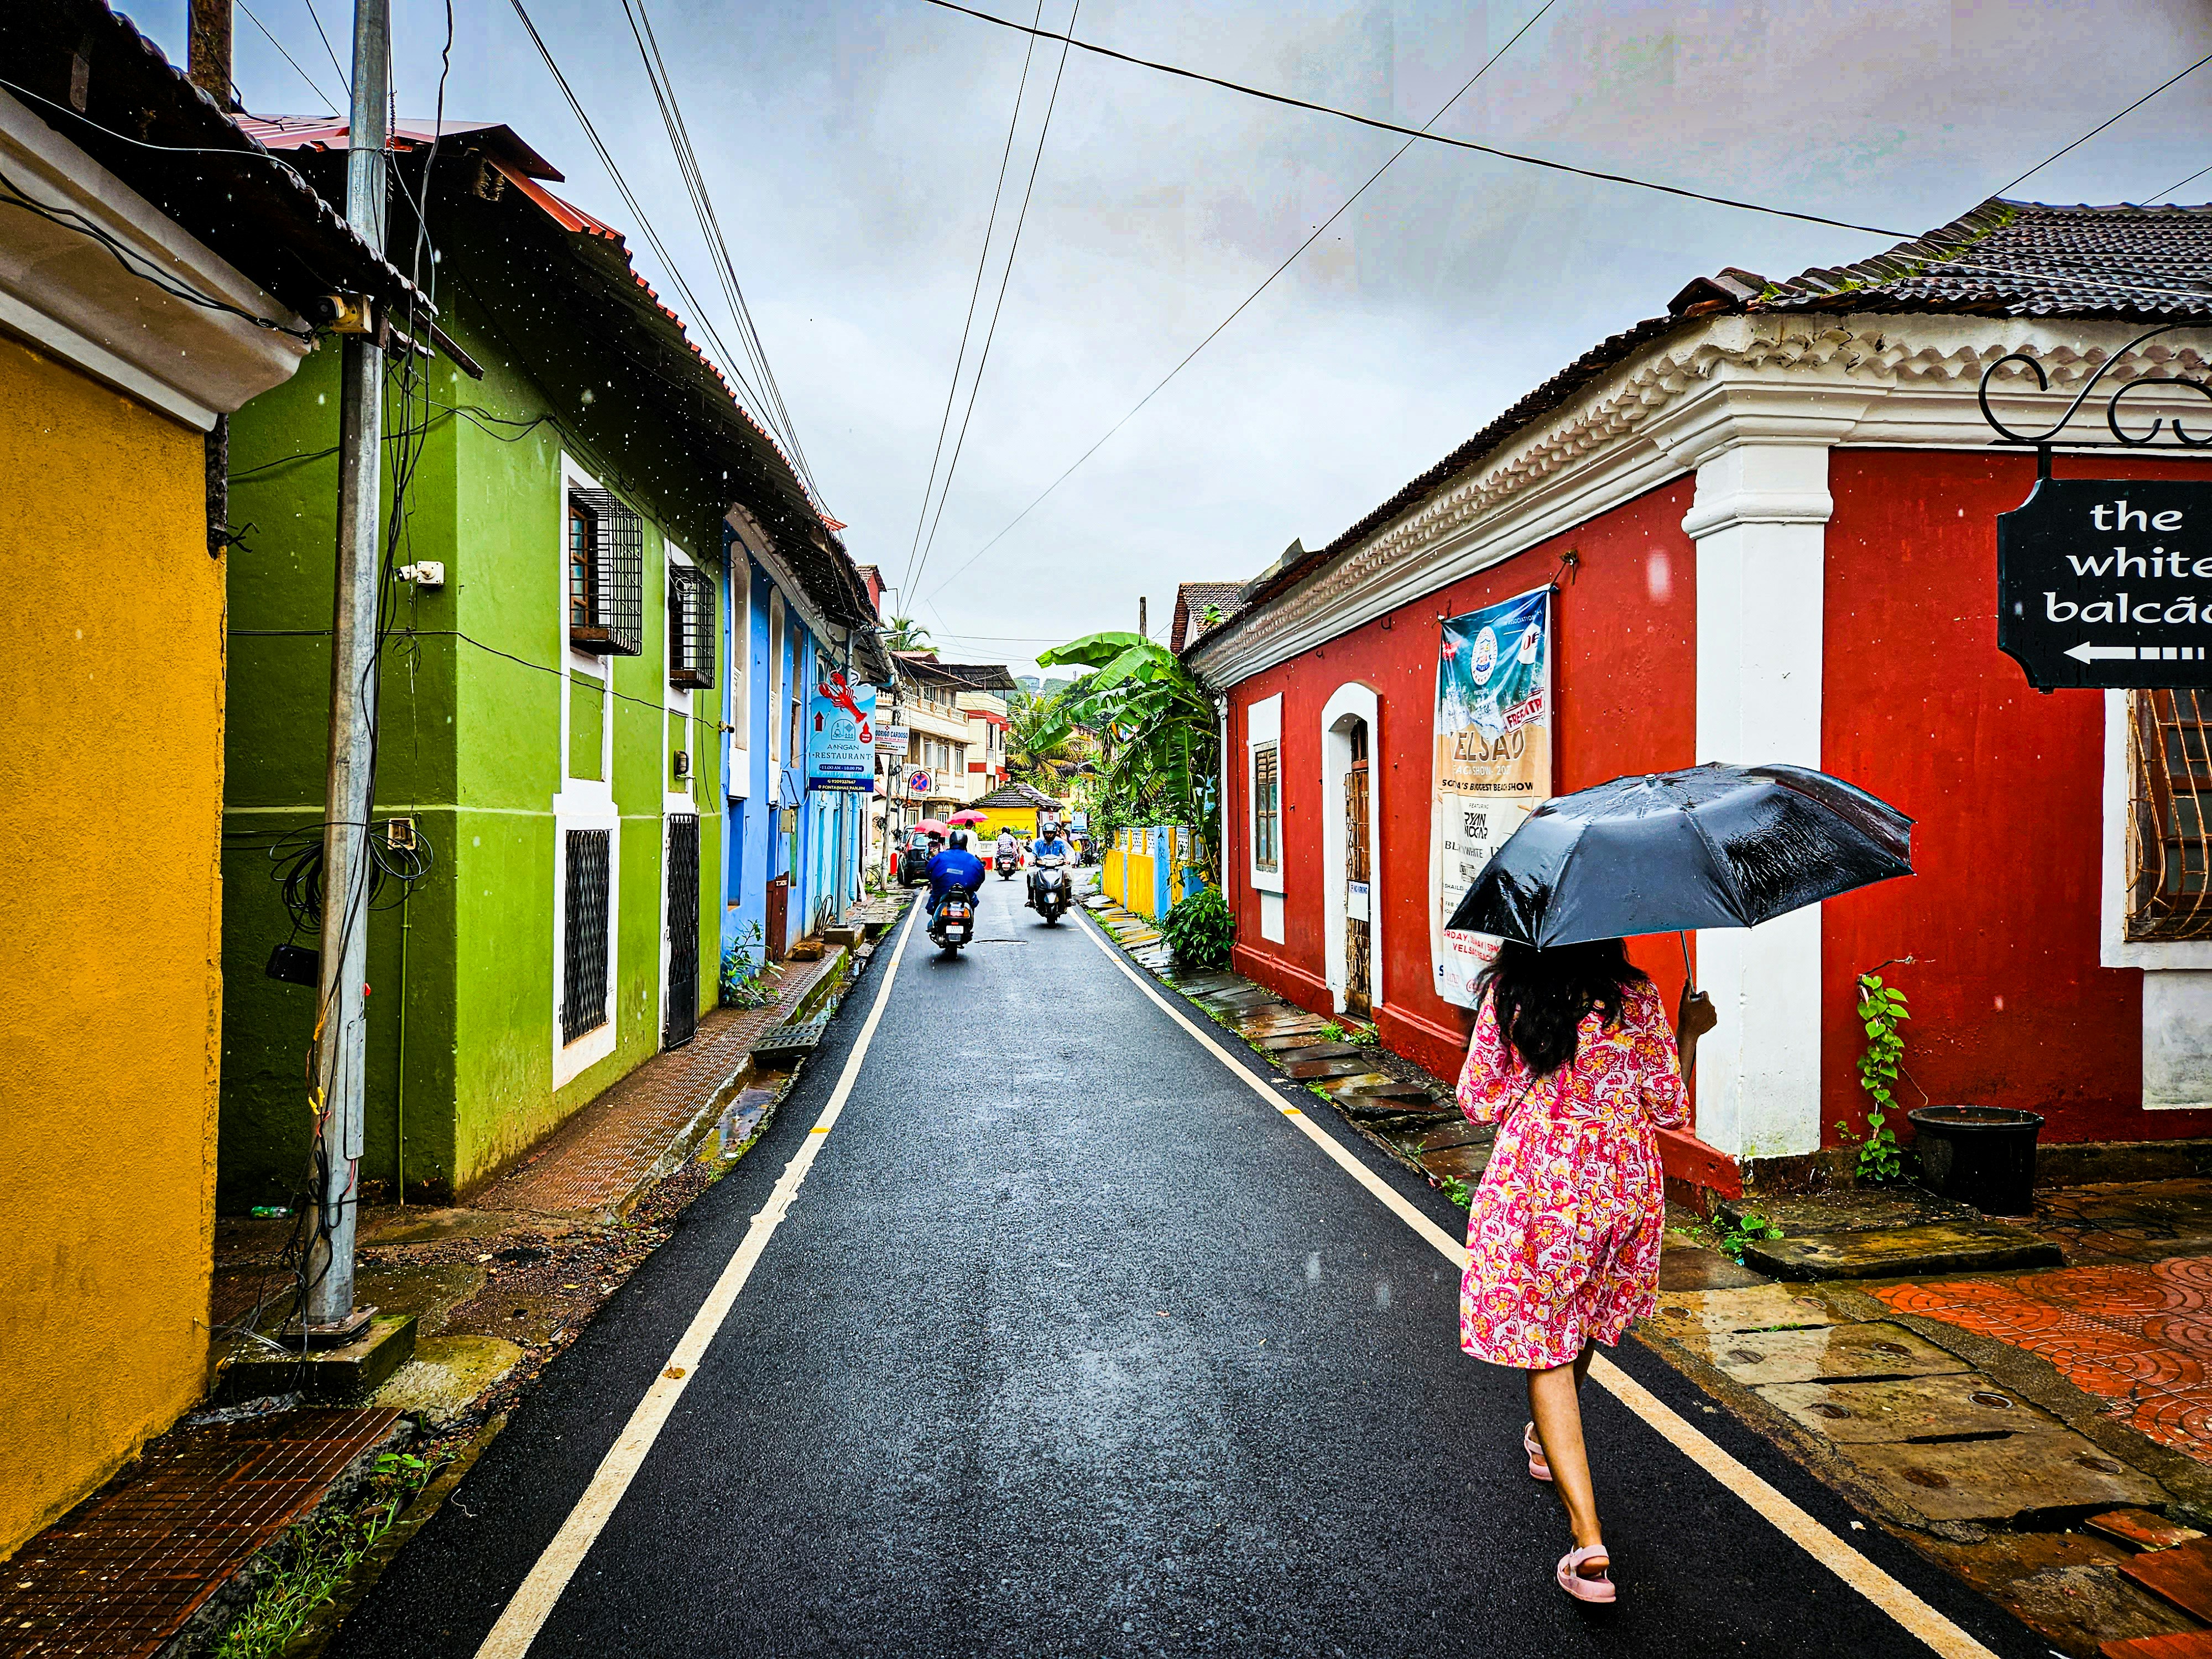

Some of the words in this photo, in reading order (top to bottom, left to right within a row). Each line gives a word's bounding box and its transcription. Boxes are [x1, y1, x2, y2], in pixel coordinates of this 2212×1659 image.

[2089, 500, 2183, 531] the
[2065, 546, 2212, 578] white
[1508, 782, 1533, 791] SHOW
